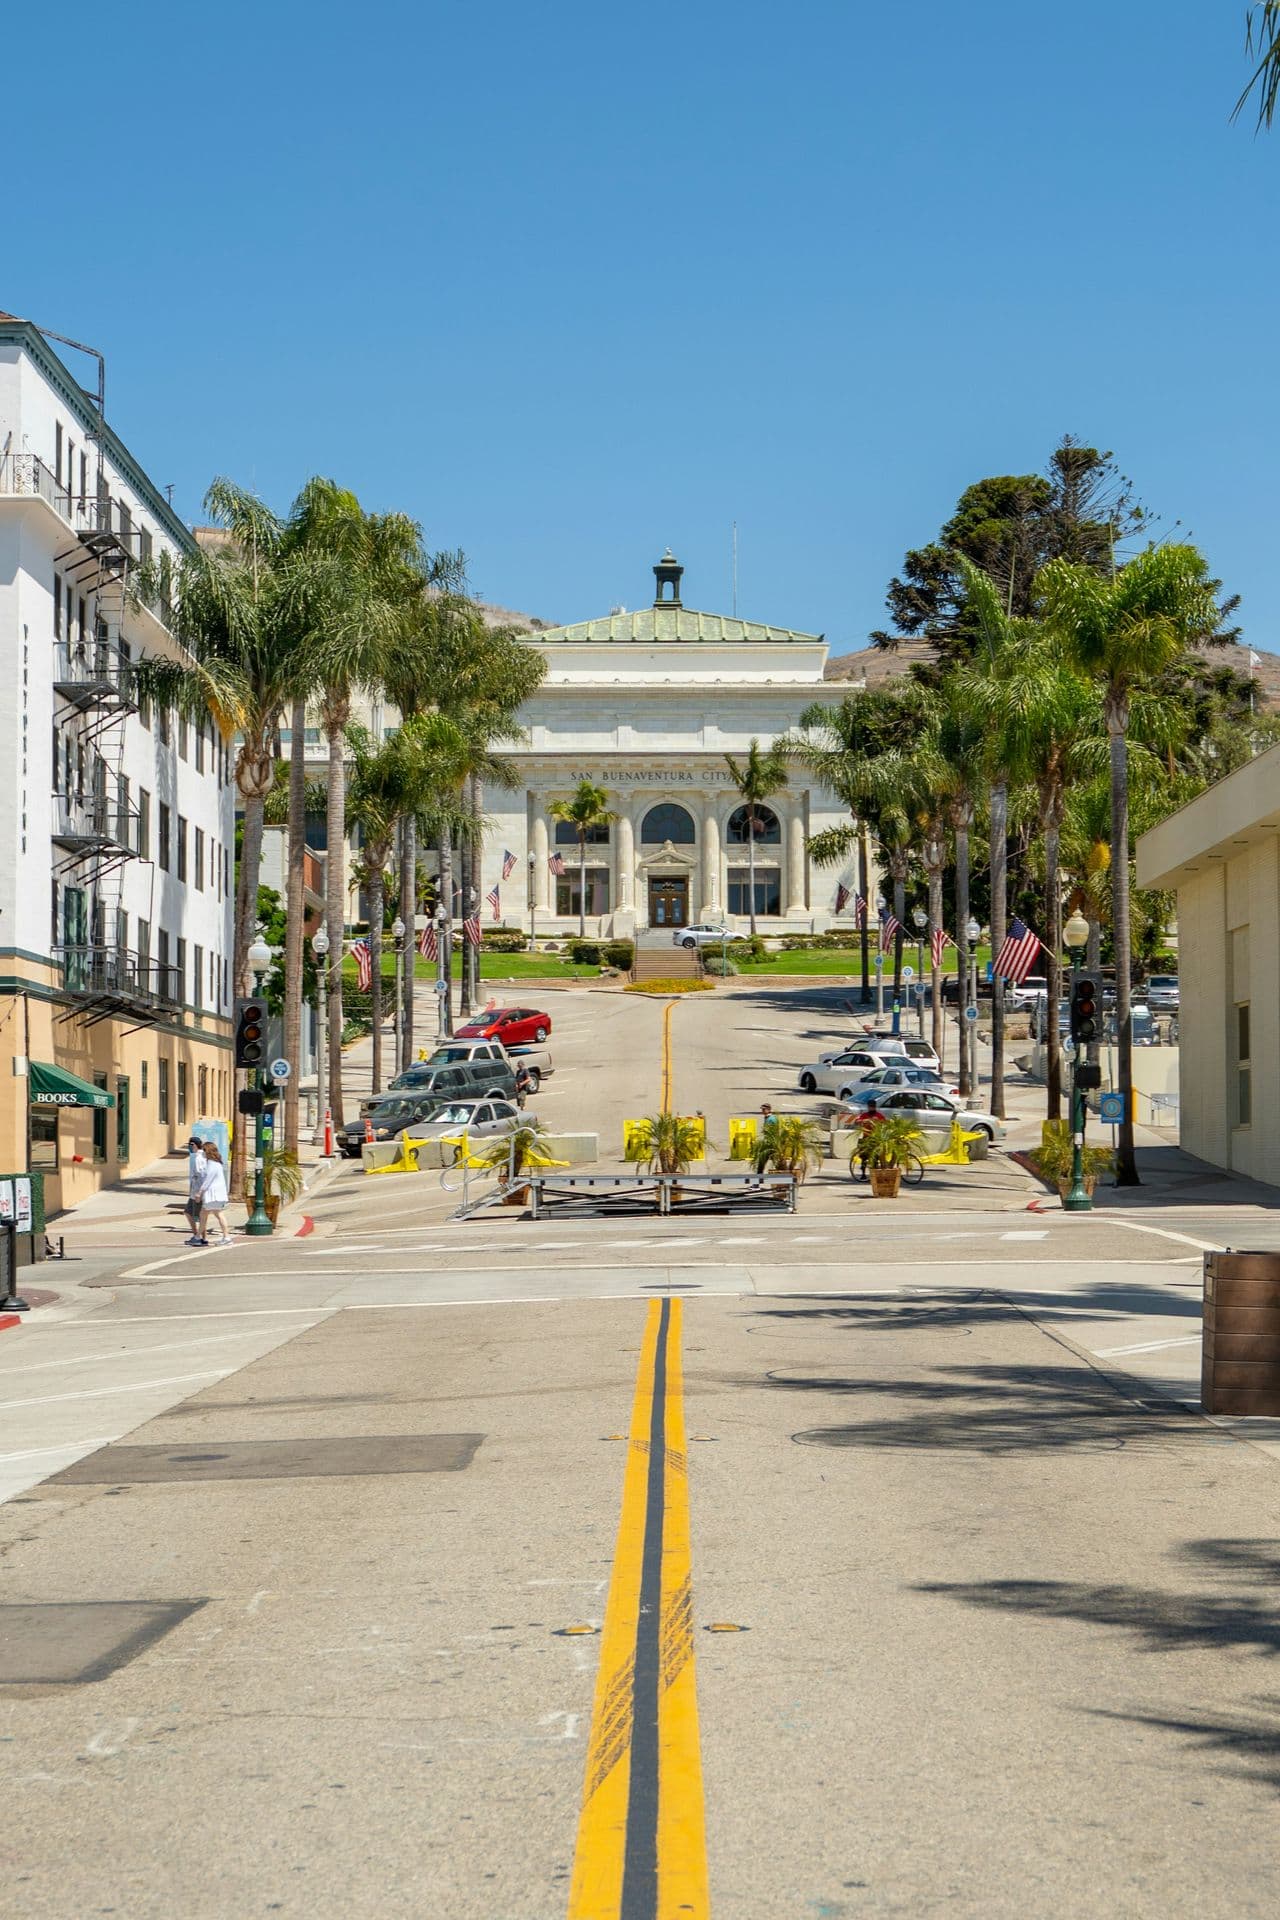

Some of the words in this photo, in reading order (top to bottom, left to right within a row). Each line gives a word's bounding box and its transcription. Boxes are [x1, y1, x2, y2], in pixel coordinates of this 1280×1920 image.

[571, 771, 593, 781] SAN
[602, 771, 693, 781] BUENAVENTURA
[702, 771, 728, 781] CITY
[37, 1093, 77, 1103] BOOKS
